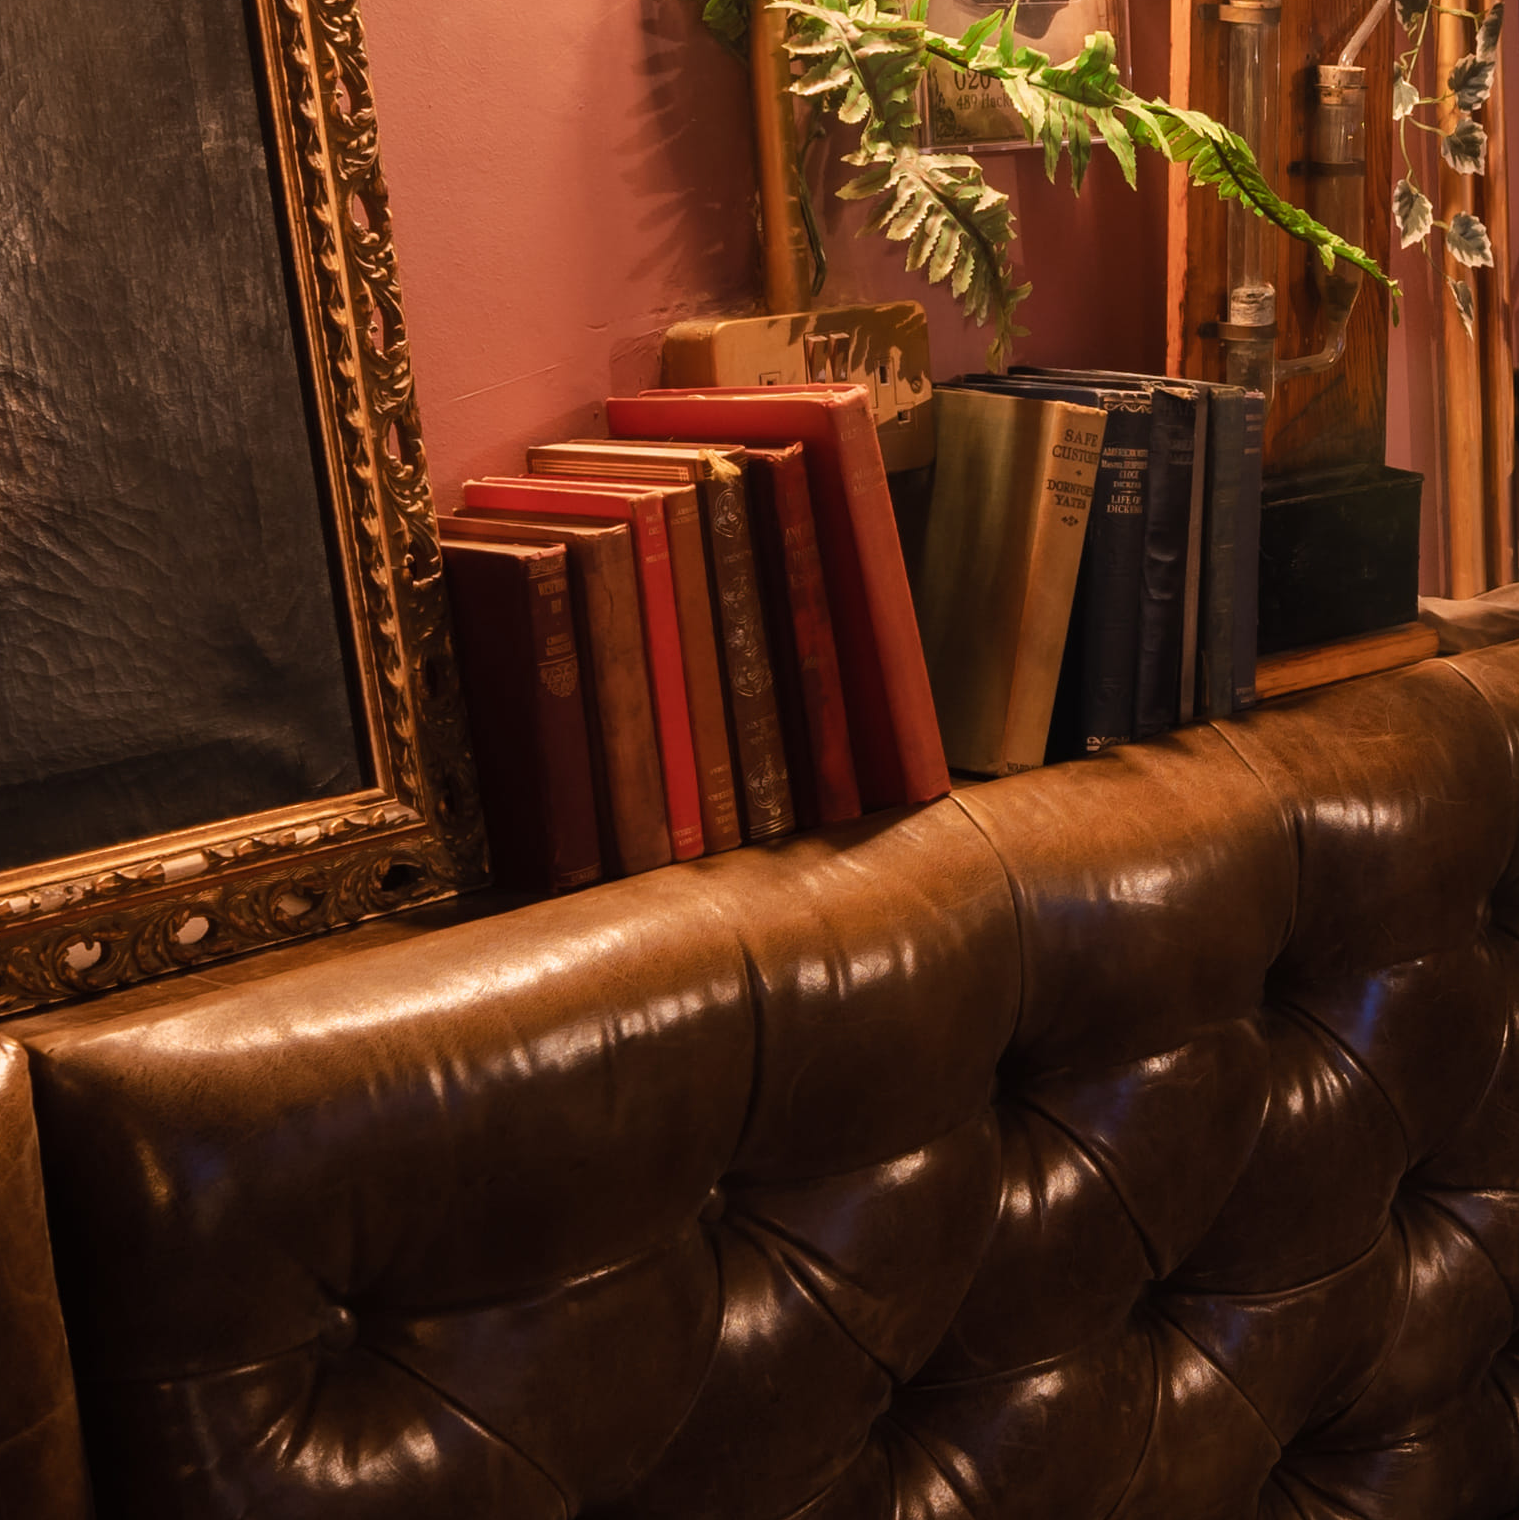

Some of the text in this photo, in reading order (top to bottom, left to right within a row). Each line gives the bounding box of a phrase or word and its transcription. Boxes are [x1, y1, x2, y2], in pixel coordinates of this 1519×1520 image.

[1064, 429, 1099, 447] SAFE
[1054, 494, 1087, 510] YATES
[1111, 494, 1132, 504] LIFE
